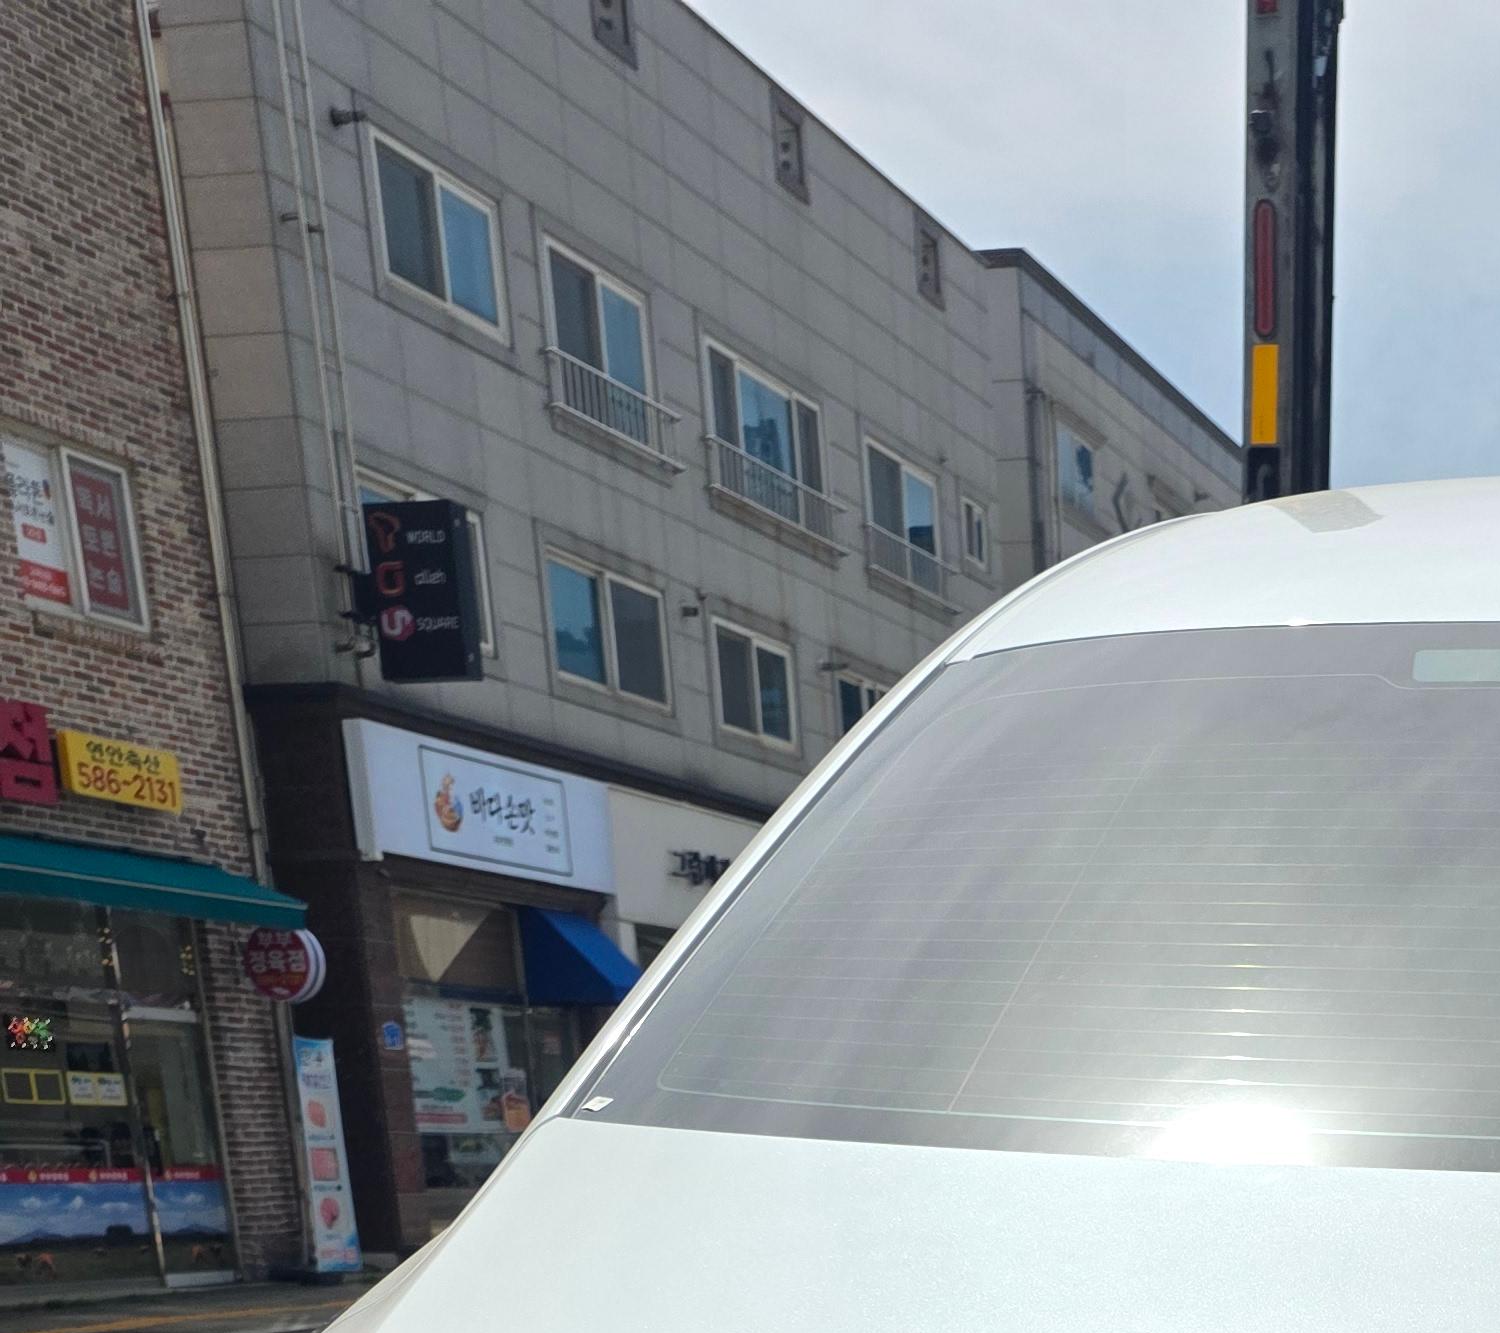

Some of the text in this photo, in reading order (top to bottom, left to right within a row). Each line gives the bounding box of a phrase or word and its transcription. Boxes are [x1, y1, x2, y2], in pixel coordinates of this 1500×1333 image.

[406, 529, 446, 545] WORLD
[417, 615, 461, 633] SQUARE
[77, 762, 177, 808] 586-2131
[469, 787, 536, 835] 바다손맛
